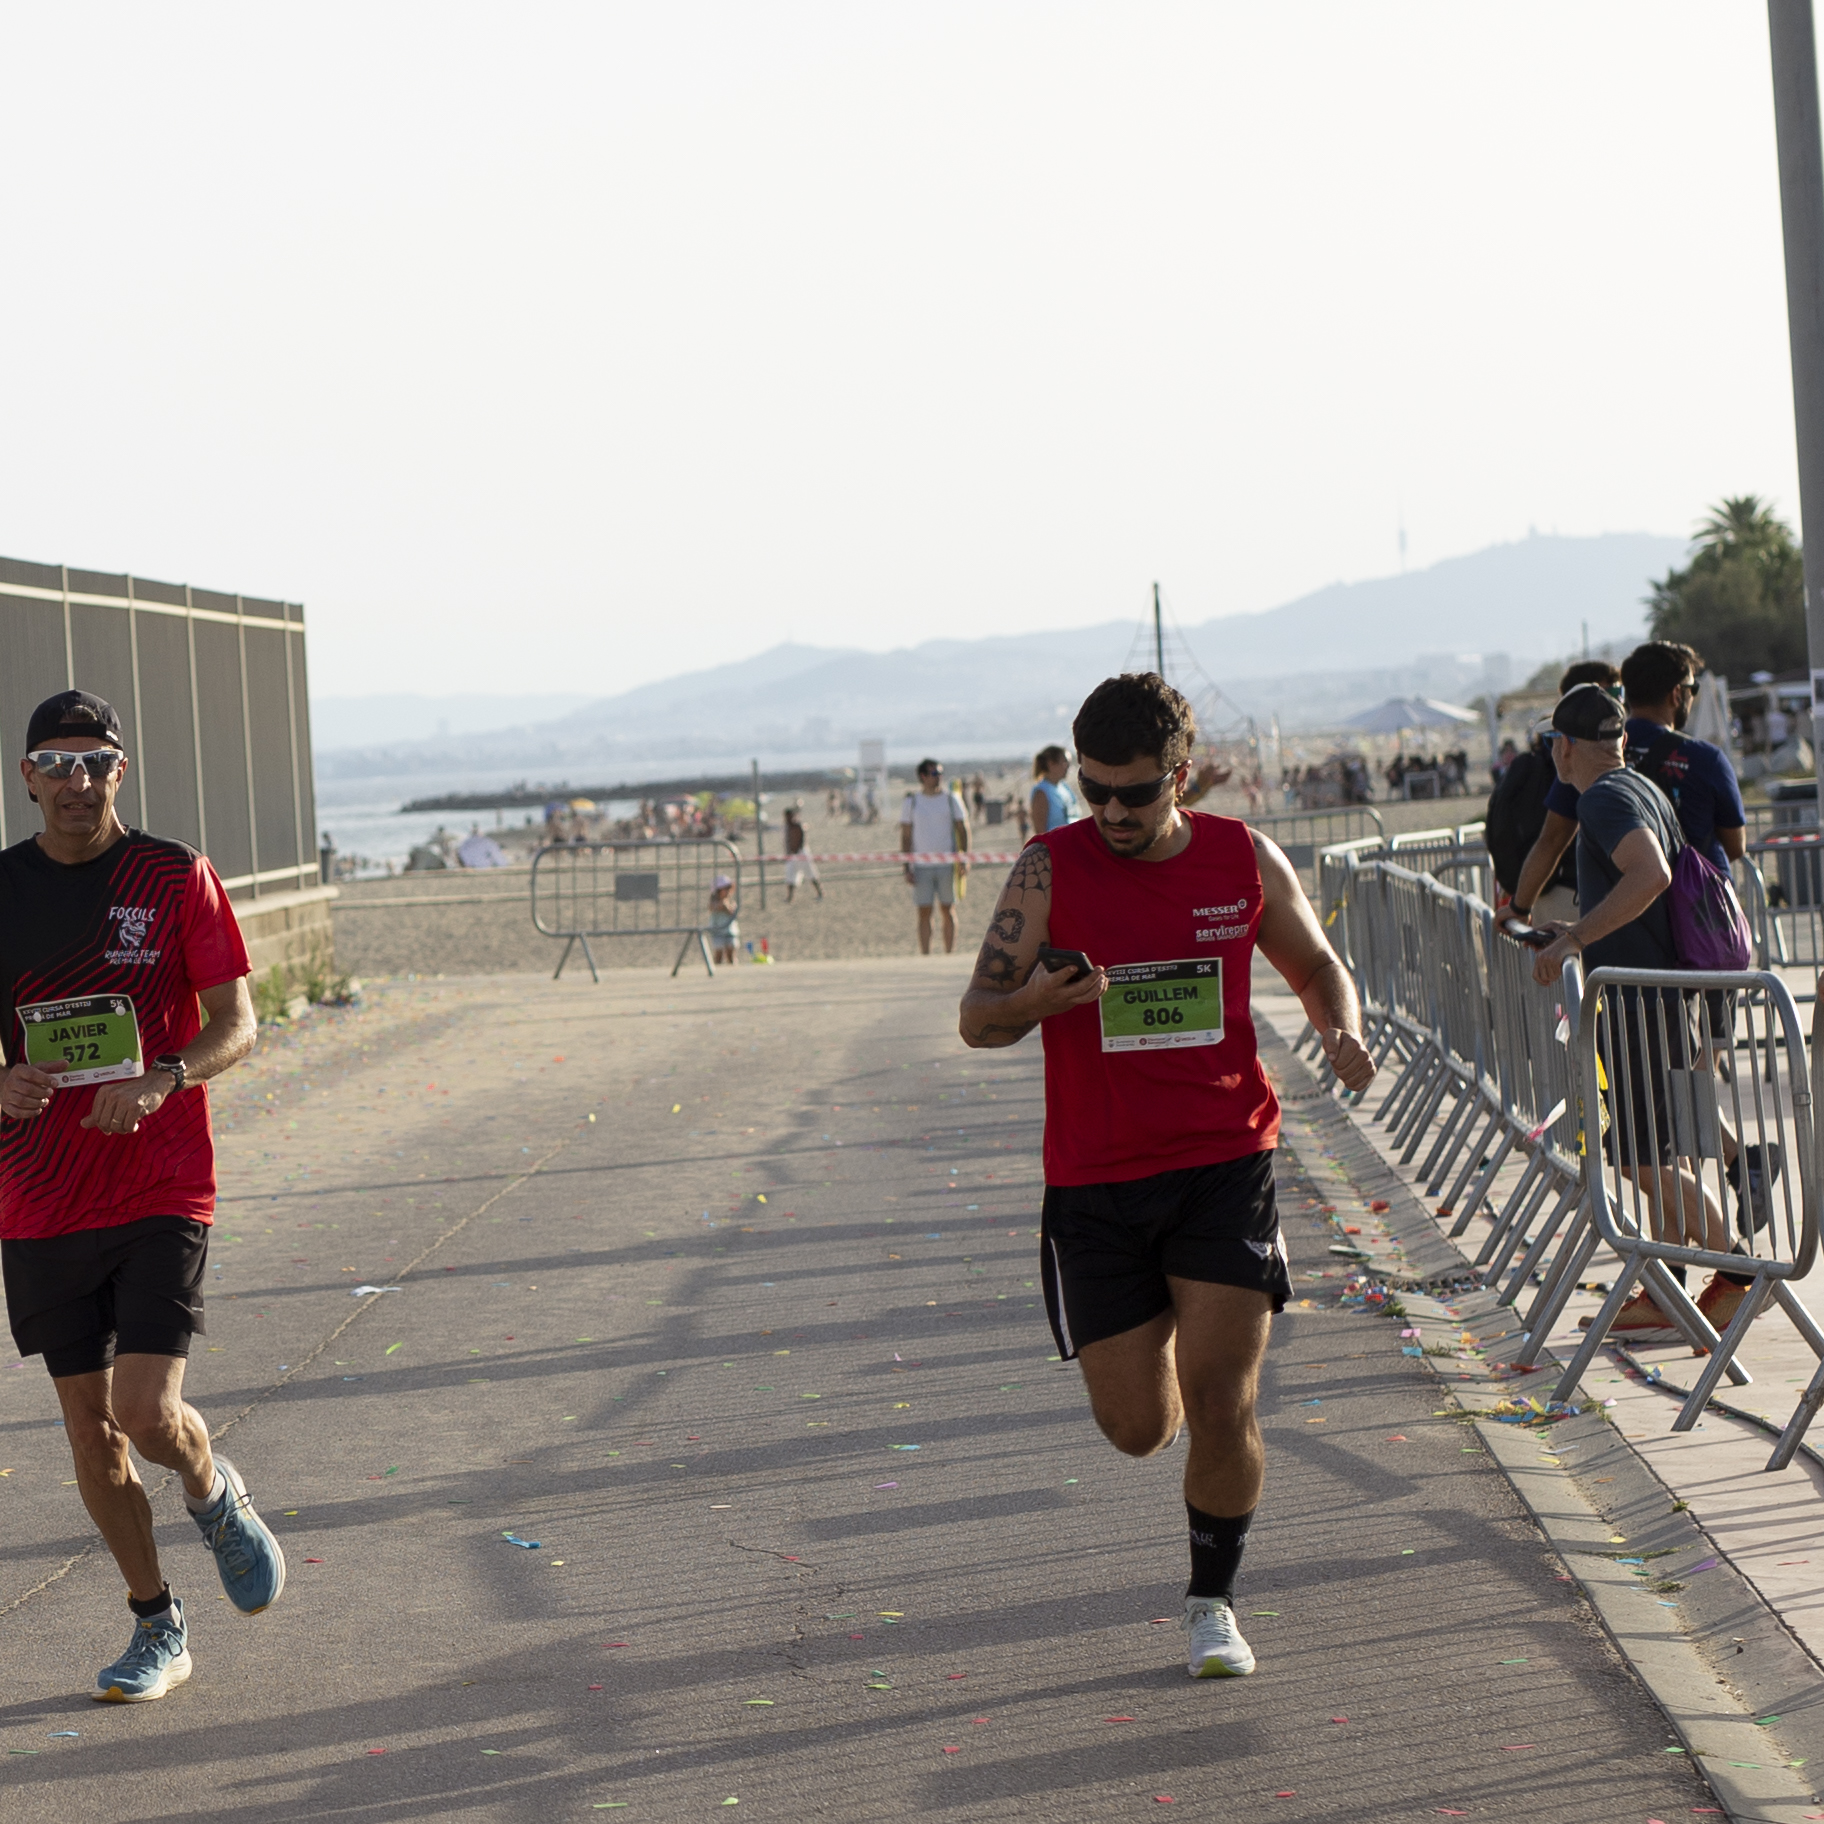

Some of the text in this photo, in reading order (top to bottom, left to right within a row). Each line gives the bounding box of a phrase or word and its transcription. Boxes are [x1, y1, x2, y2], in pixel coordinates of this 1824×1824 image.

[108, 906, 156, 922] FOSSILS
[1192, 905, 1239, 917] MESSER
[1196, 964, 1212, 974] 5K
[1123, 986, 1199, 1004] GUILLEM
[109, 999, 124, 1009] 5K
[1142, 1006, 1184, 1027] 806
[48, 1022, 109, 1043] JAVIER
[62, 1042, 101, 1063] 572
